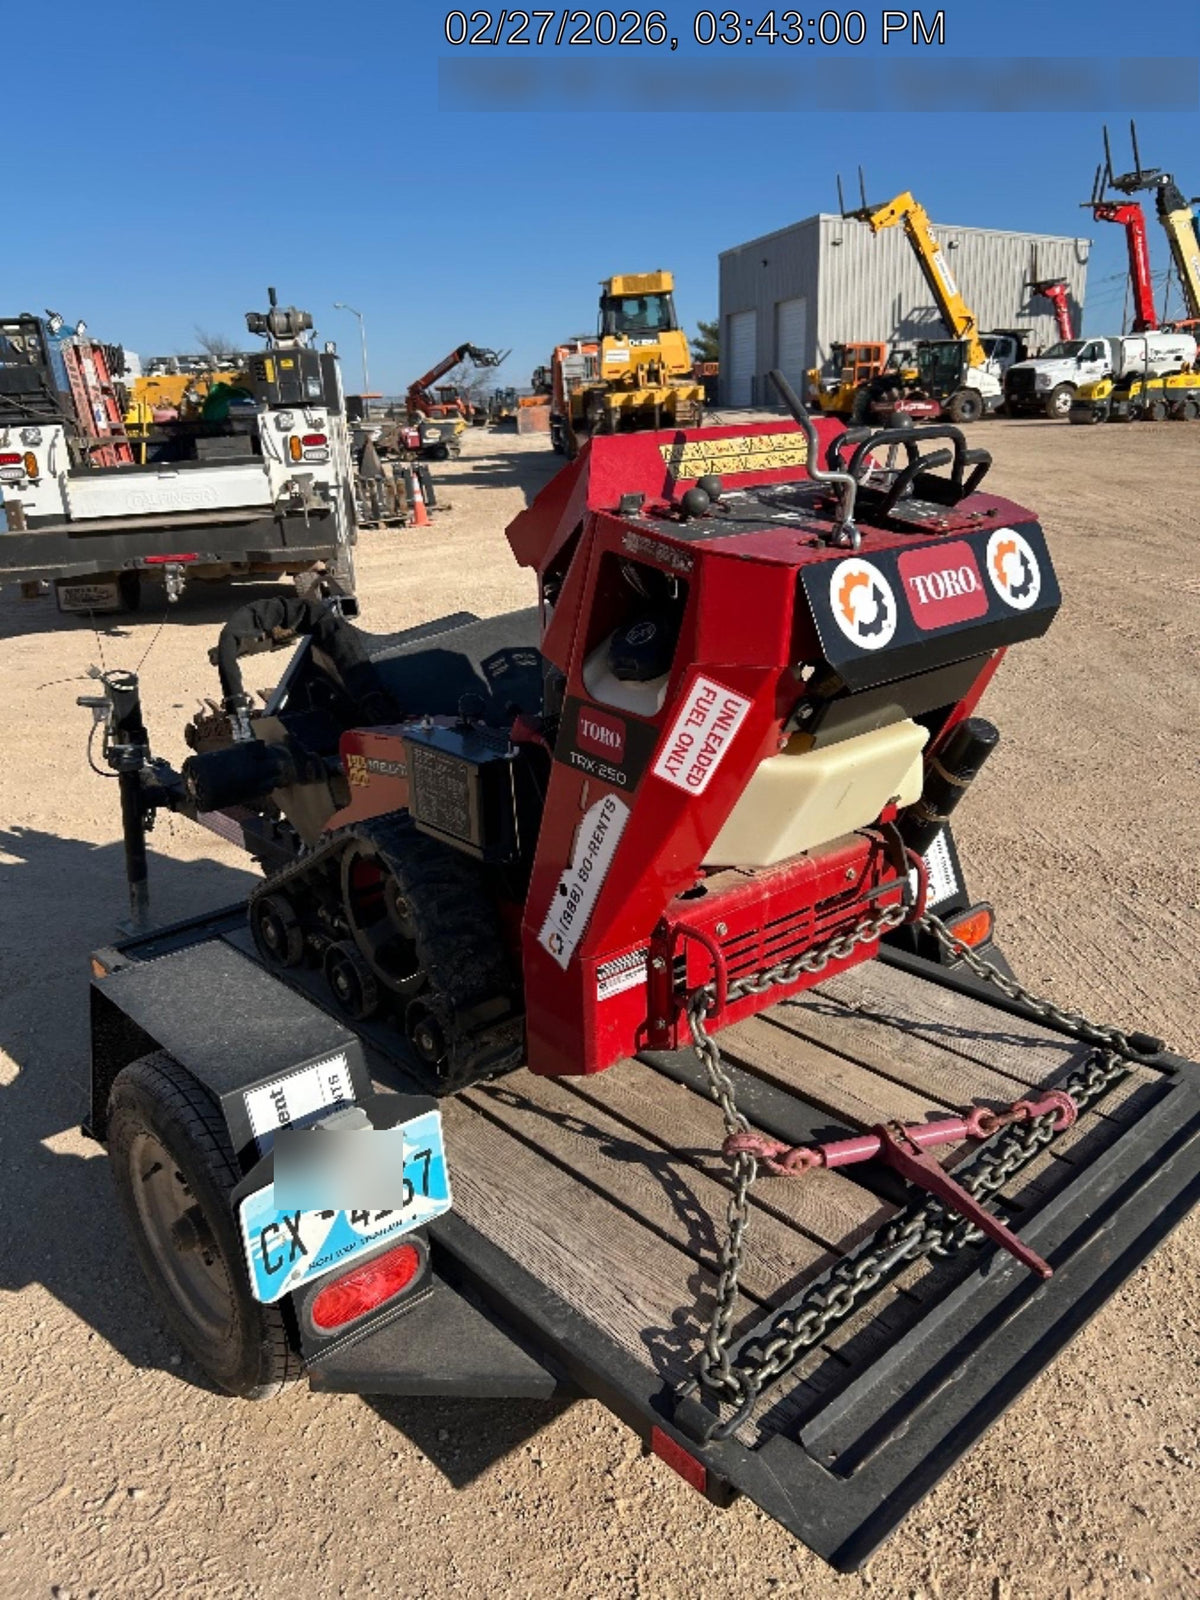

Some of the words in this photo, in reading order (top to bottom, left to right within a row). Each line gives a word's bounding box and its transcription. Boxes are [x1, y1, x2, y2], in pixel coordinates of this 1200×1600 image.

[909, 565, 977, 605] TORO
[684, 686, 717, 728] FUEL
[580, 719, 622, 748] TORO
[664, 732, 694, 778] ONLY
[686, 698, 742, 787] UNLEADED
[577, 798, 617, 883] 80-RENTS
